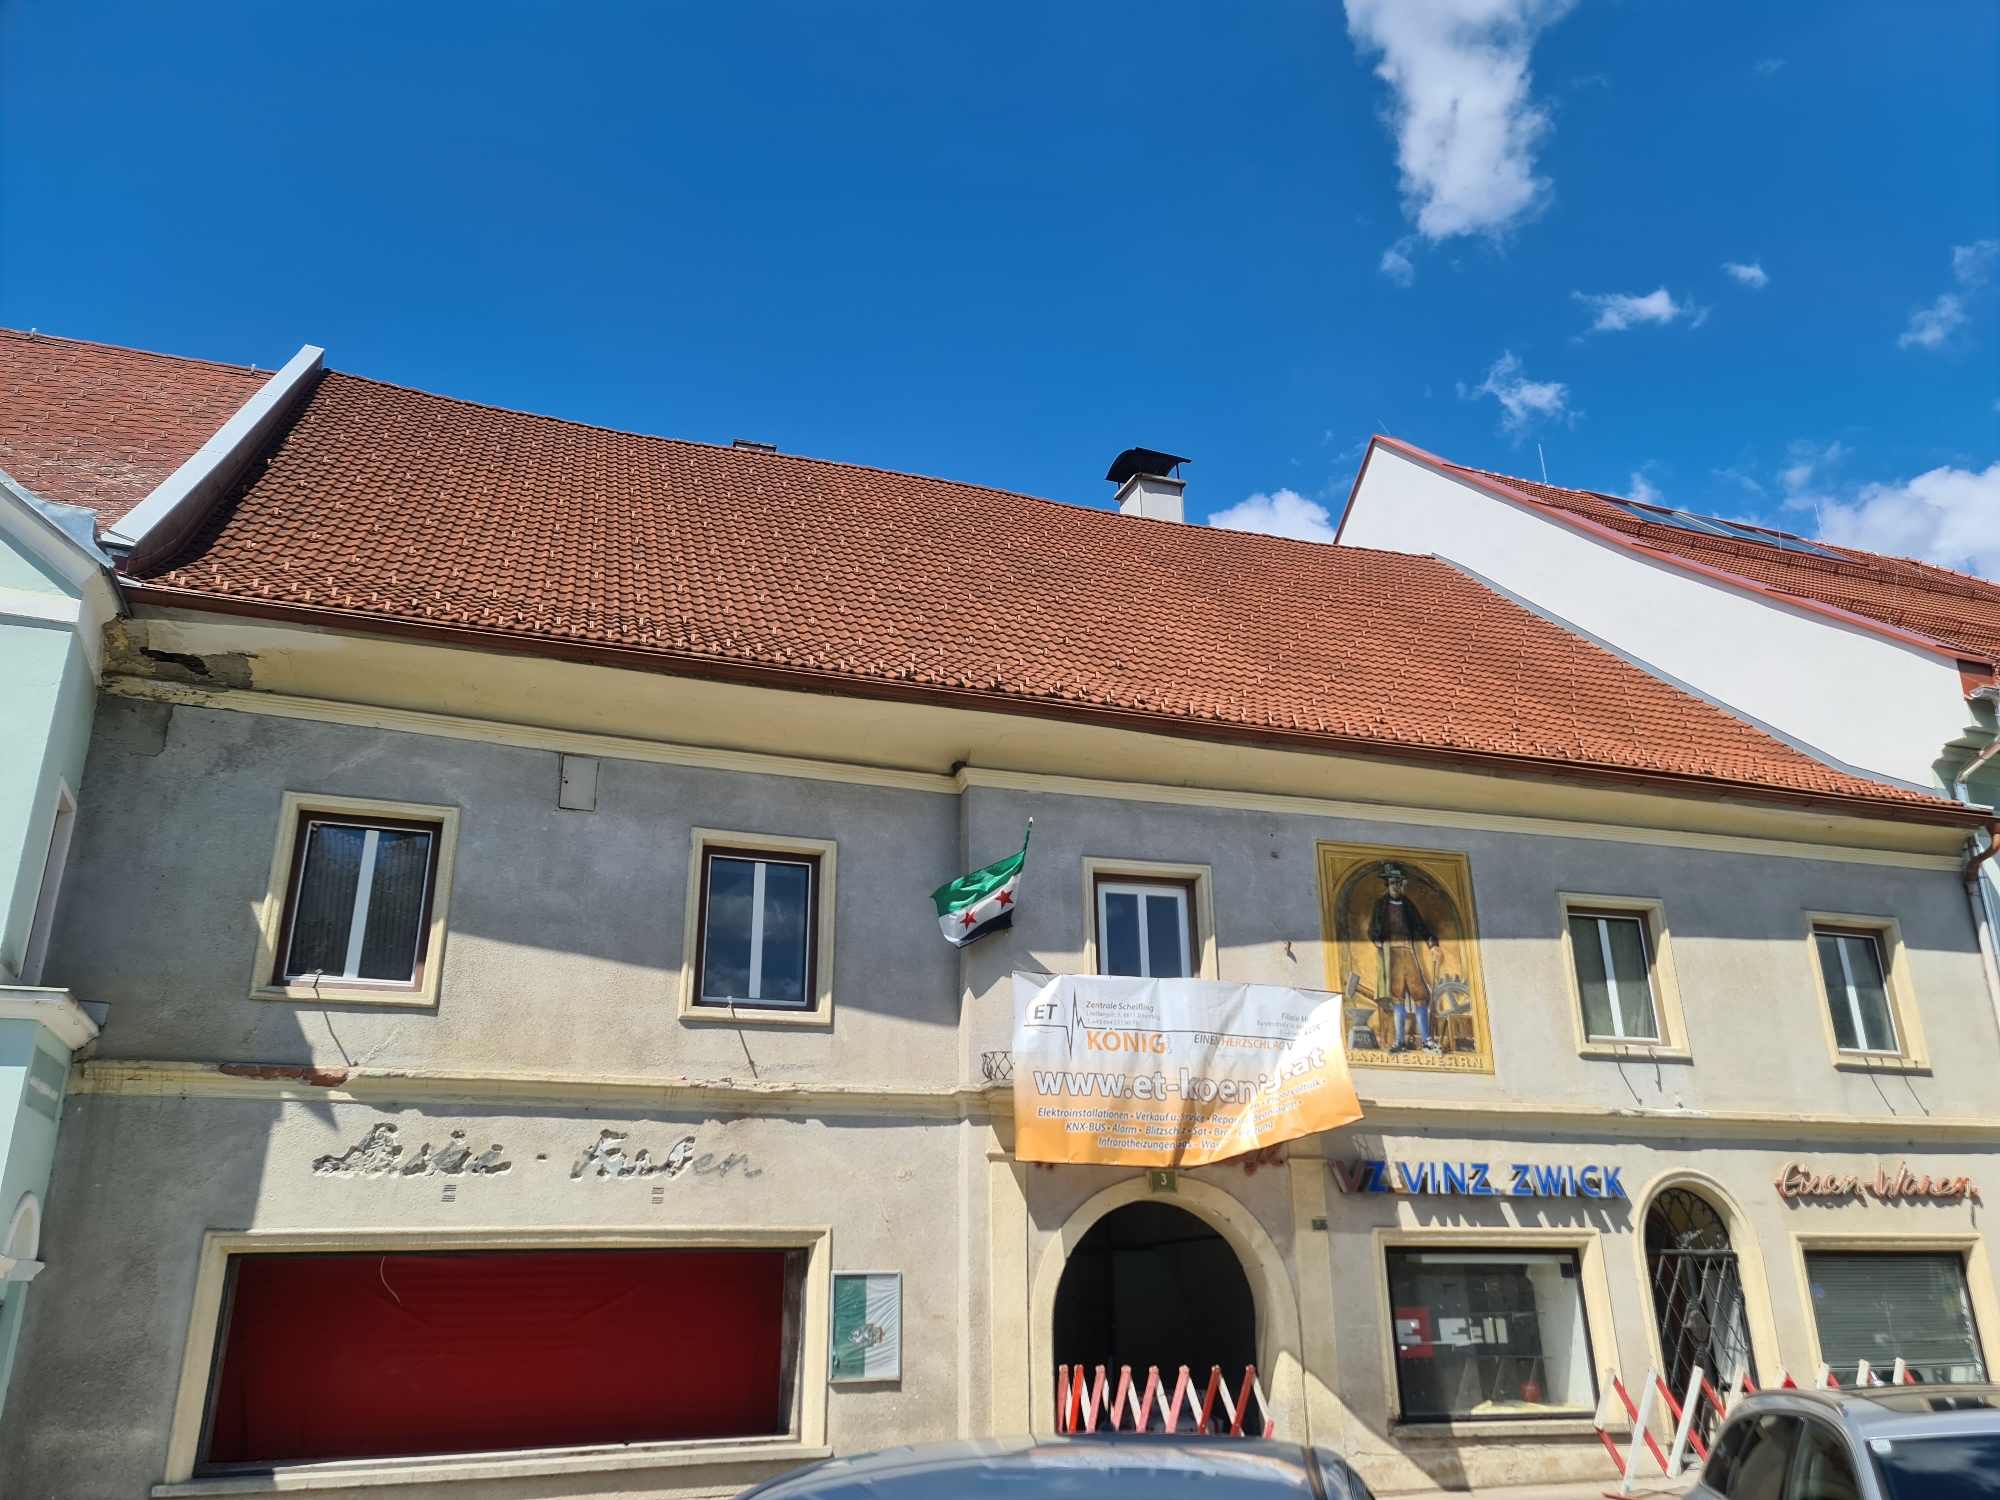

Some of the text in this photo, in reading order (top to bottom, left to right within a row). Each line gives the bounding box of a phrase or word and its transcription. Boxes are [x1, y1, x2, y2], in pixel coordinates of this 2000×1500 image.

[1033, 1003, 1058, 1020] ET
[1085, 1001, 1155, 1012] Zentrale Scheifling
[1194, 1033, 1220, 1047] EINEN
[1221, 1037, 1285, 1051] HERZSCHLAG
[1033, 1046, 1327, 1105] www.et-koenig.at
[1038, 1107, 1129, 1120] Elektroinstallationen
[1135, 1111, 1168, 1122] Verkauf
[1180, 1112, 1205, 1124] Srvice
[1065, 1121, 1107, 1132] KNX-BUS
[1111, 1125, 1137, 1134] Alarm
[1192, 1126, 1207, 1136] Sat
[1098, 1136, 1175, 1151] Infrarotheizungen
[1160, 1172, 1168, 1186] 3
[1400, 1161, 1500, 1196] VINZ.
[1510, 1163, 1626, 1198] ZWICK
